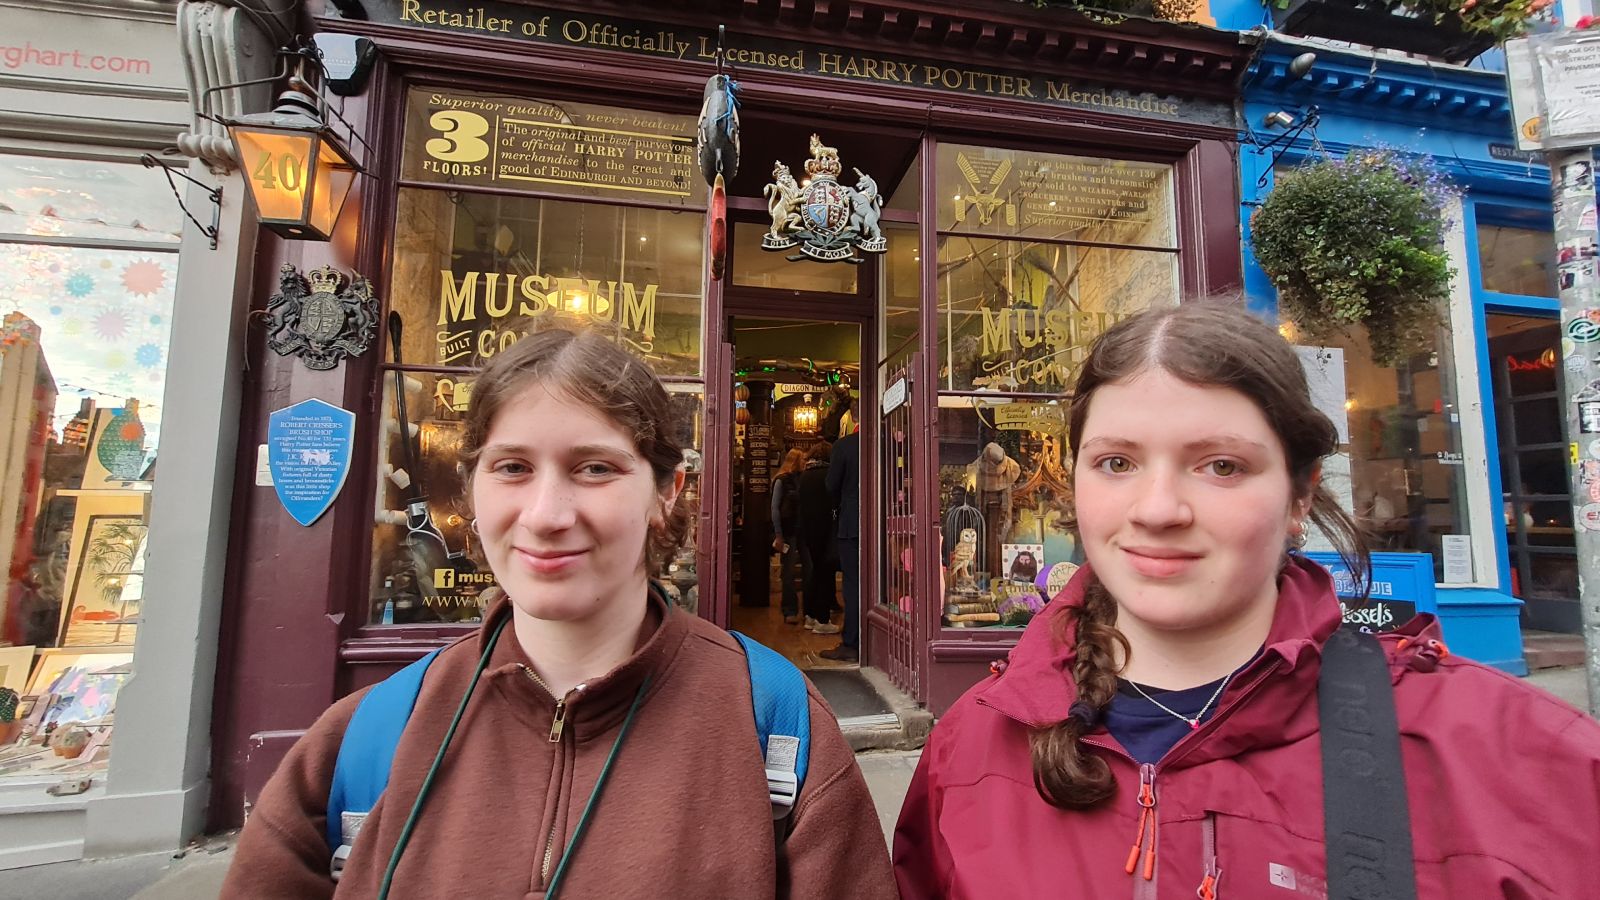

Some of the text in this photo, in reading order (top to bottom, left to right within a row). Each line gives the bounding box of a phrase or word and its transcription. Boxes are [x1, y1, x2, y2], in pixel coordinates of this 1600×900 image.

[400, 0, 514, 33] Retailer
[521, 16, 552, 37] of
[563, 20, 691, 61] Officially
[698, 36, 806, 73] Lcensed
[817, 53, 918, 83] HARRY
[1046, 81, 1180, 115] Merchandise
[429, 94, 503, 115] Superior
[507, 104, 565, 124] quality
[585, 114, 628, 125] never
[425, 110, 489, 163] 3
[503, 123, 693, 154] The original and best purveyors
[501, 136, 693, 166] of official HARRY POTTER
[501, 151, 692, 178] merchandise to the great and
[253, 150, 302, 192] 40
[423, 160, 489, 177] FLOORS!
[499, 164, 692, 192] good of EDINBURGH AND BEYOND!
[1090, 175, 1107, 184] and
[1101, 165, 1115, 174] for
[1116, 168, 1136, 177] over
[1128, 200, 1146, 209] and
[436, 270, 660, 341] MUSEUM
[439, 337, 471, 357] BUILT
[458, 573, 498, 584] mus
